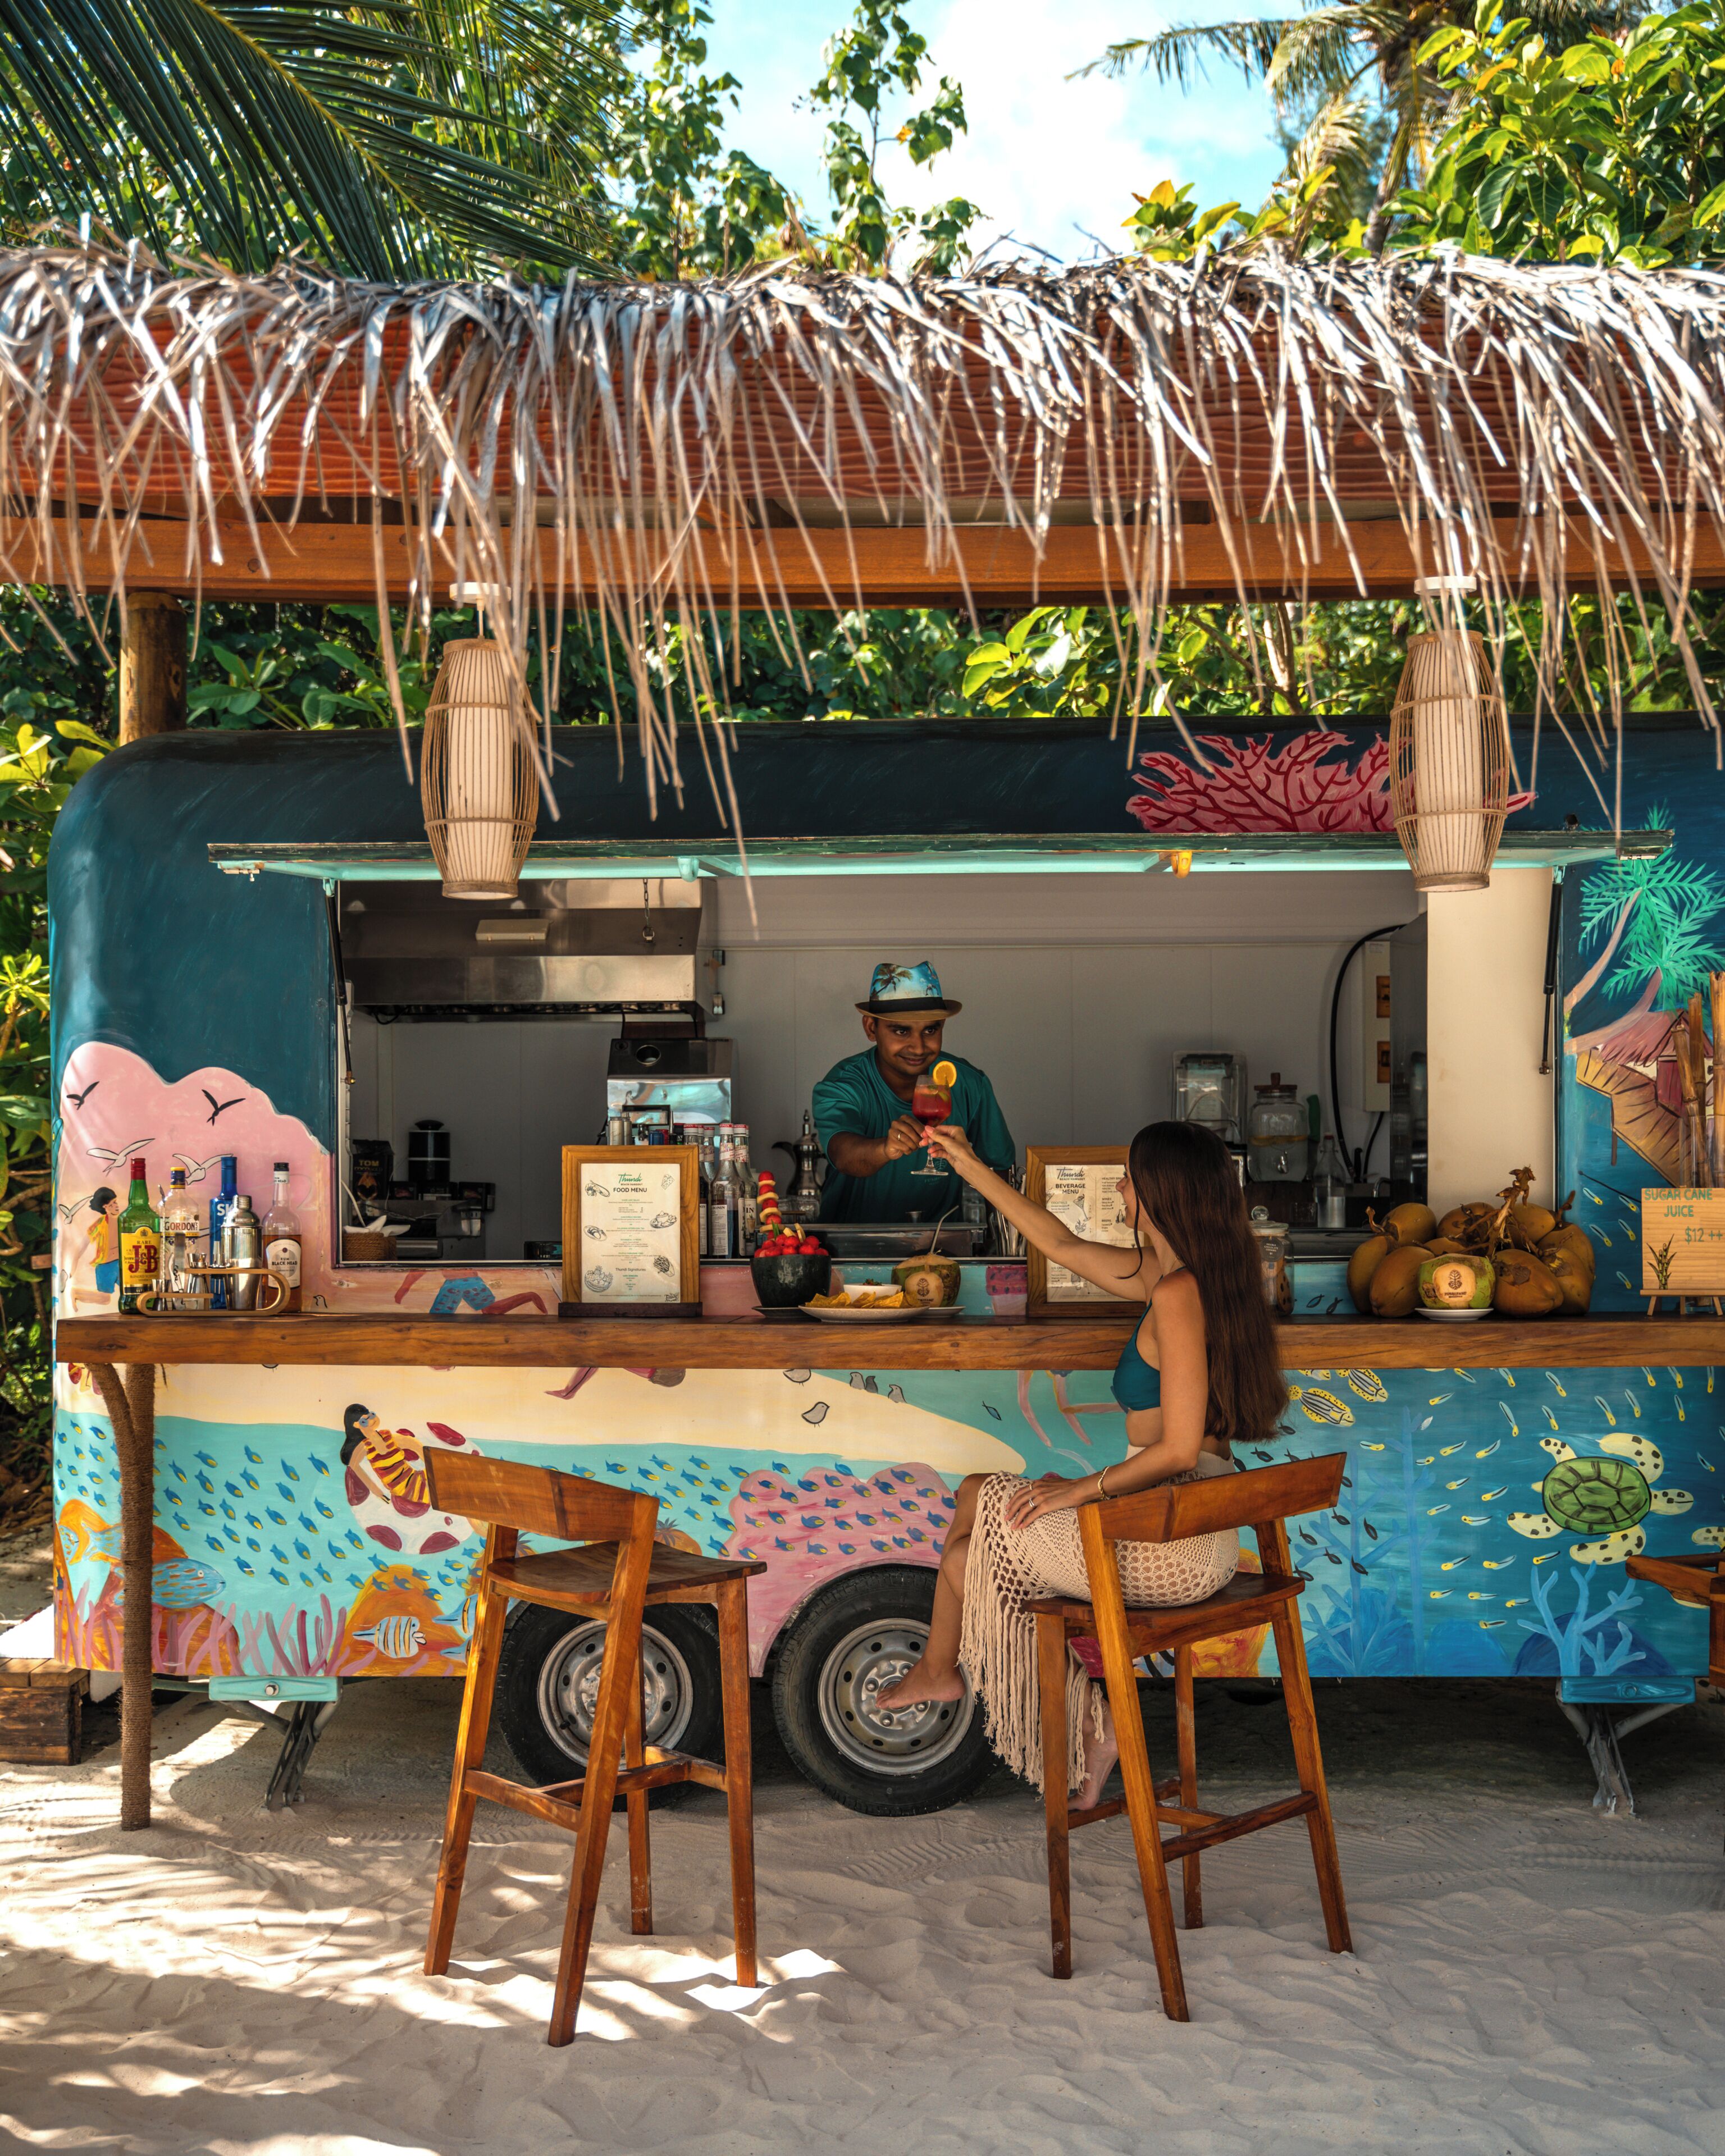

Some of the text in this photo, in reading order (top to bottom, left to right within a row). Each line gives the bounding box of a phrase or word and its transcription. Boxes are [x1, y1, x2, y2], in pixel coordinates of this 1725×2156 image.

[1057, 1167, 1085, 1179] Thundi
[1645, 1189, 1713, 1200] SUGAR CANE
[217, 1203, 234, 1216] SK
[1664, 1205, 1694, 1217] JUICE
[1685, 1226, 1704, 1245] $12
[128, 1245, 158, 1273] J&B
